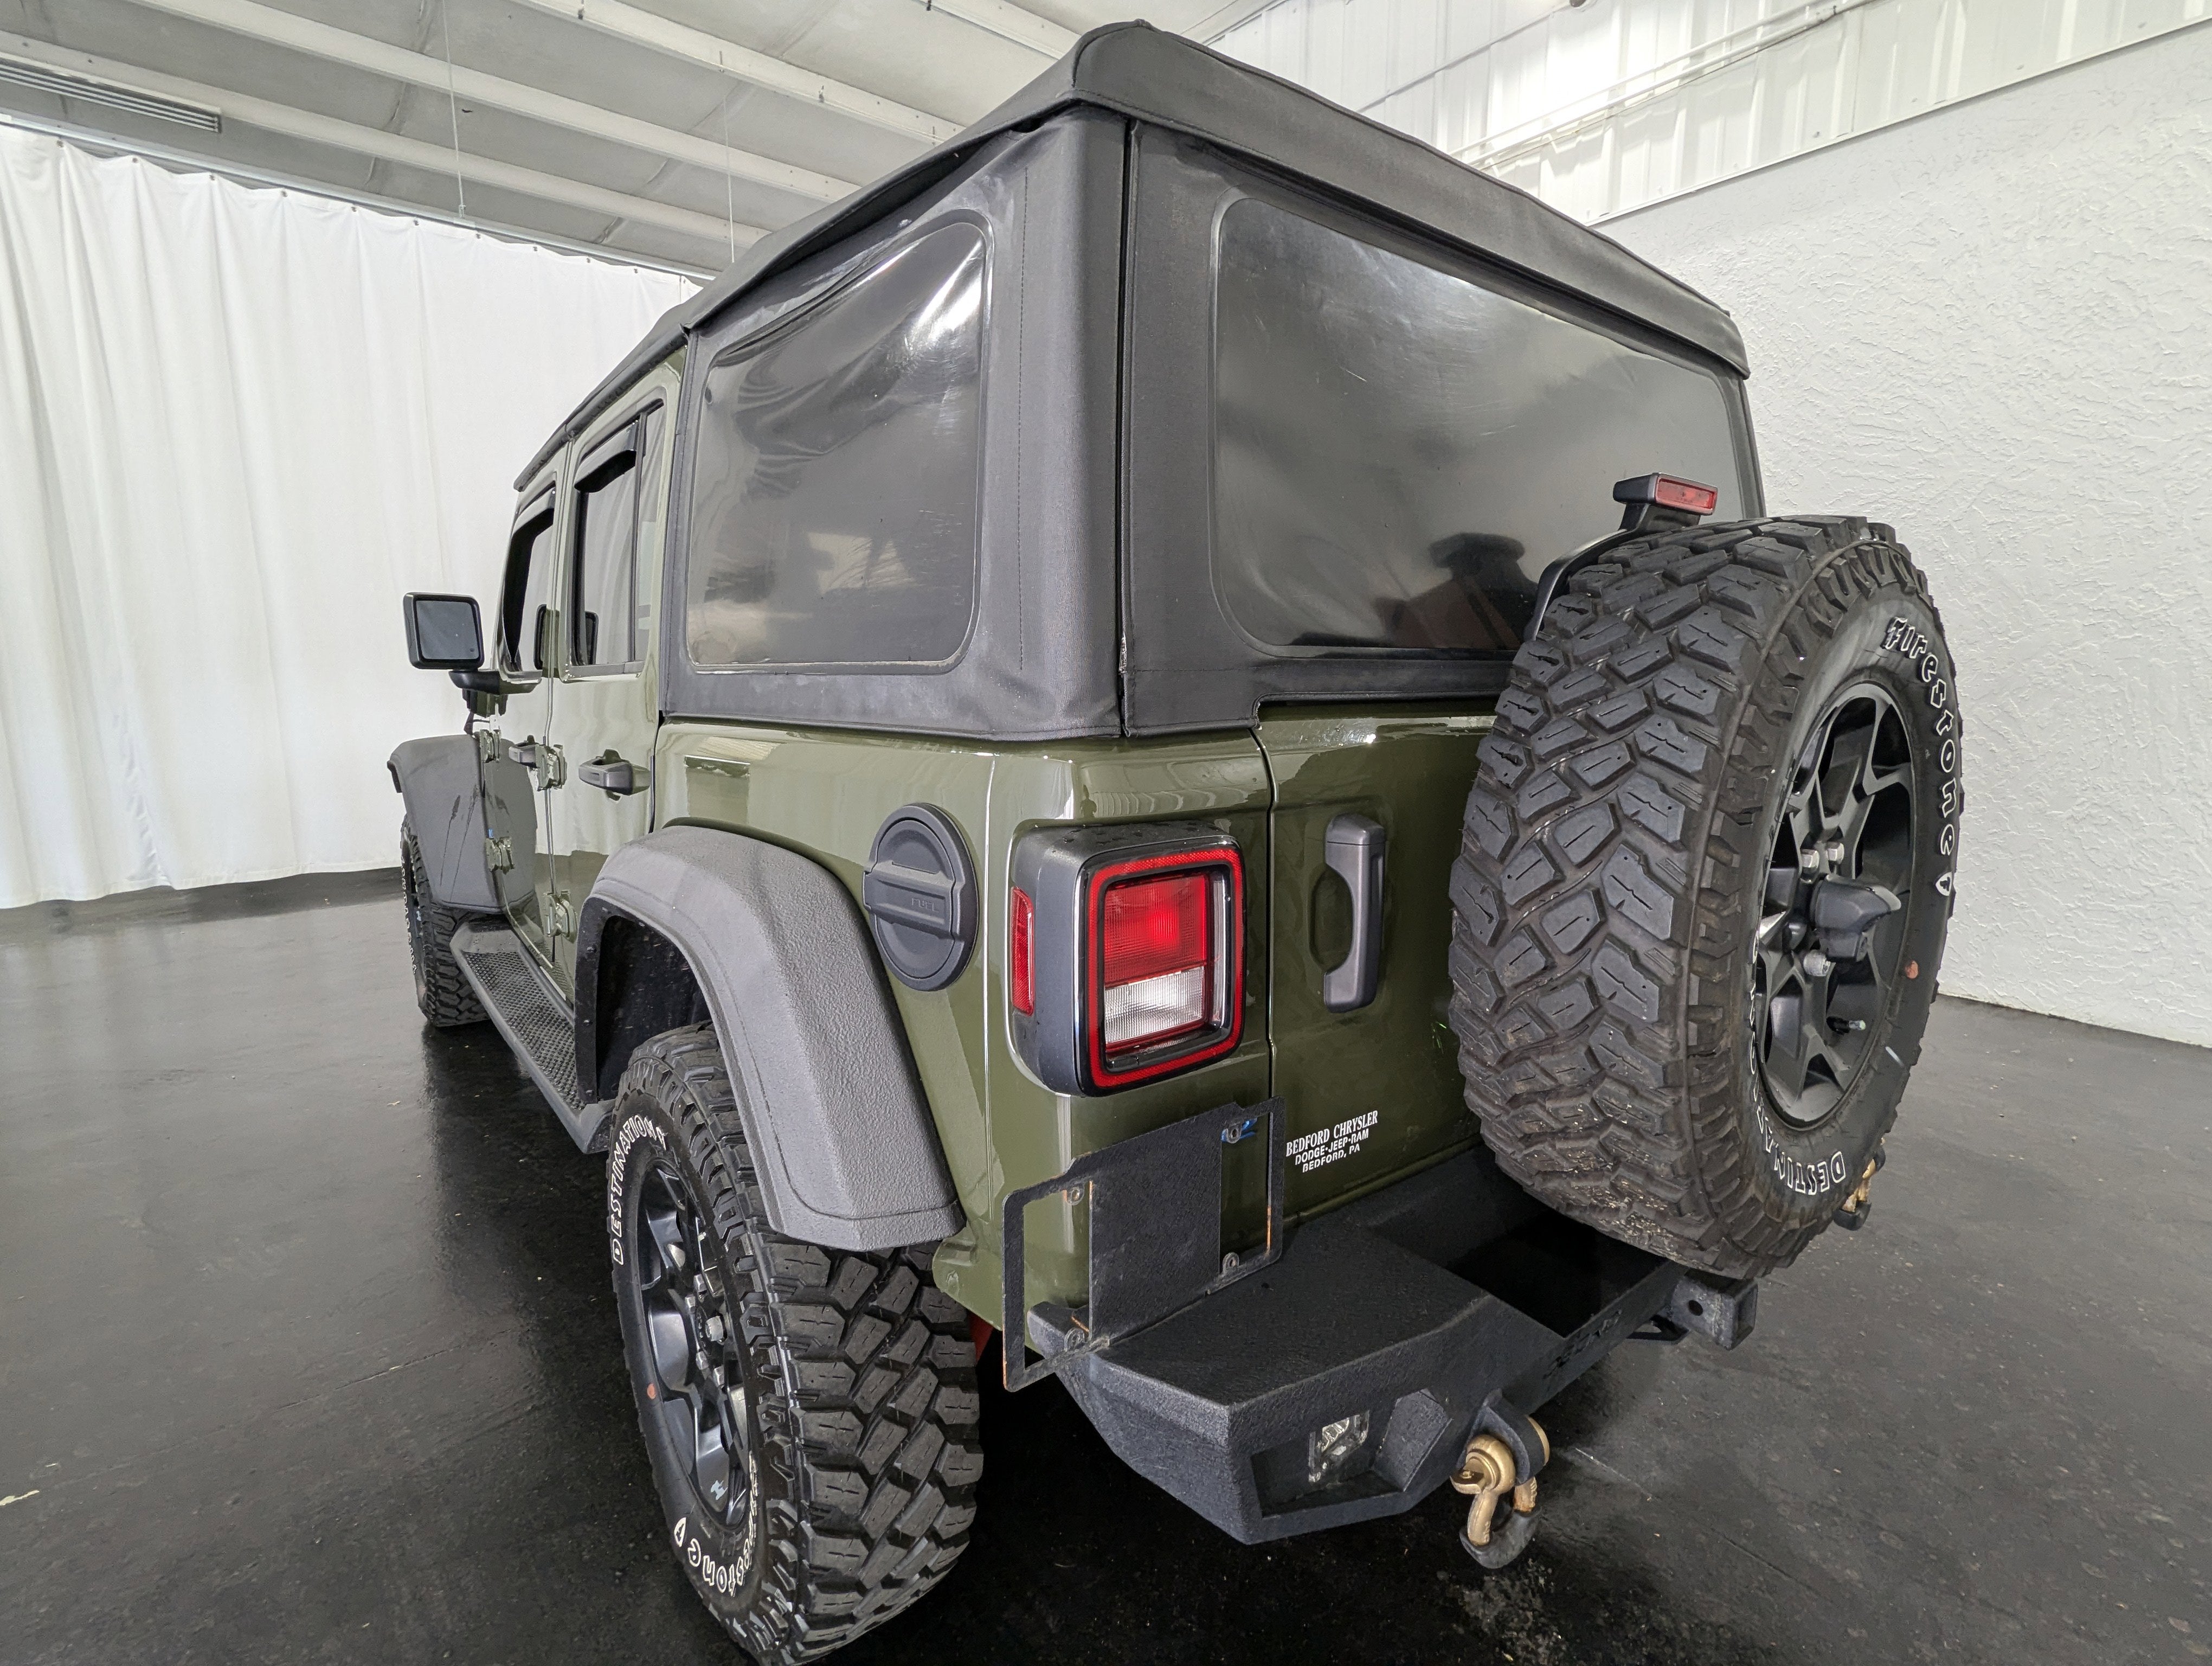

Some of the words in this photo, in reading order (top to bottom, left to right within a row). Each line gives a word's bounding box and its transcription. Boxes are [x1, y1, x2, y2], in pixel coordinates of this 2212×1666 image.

[911, 898, 939, 912] FUEL
[1285, 1129, 1329, 1157] BEDFORD
[1333, 1110, 1378, 1139] CHRYSLER
[1302, 1152, 1347, 1172] BEDFORD,
[1349, 1144, 1360, 1155] PA
